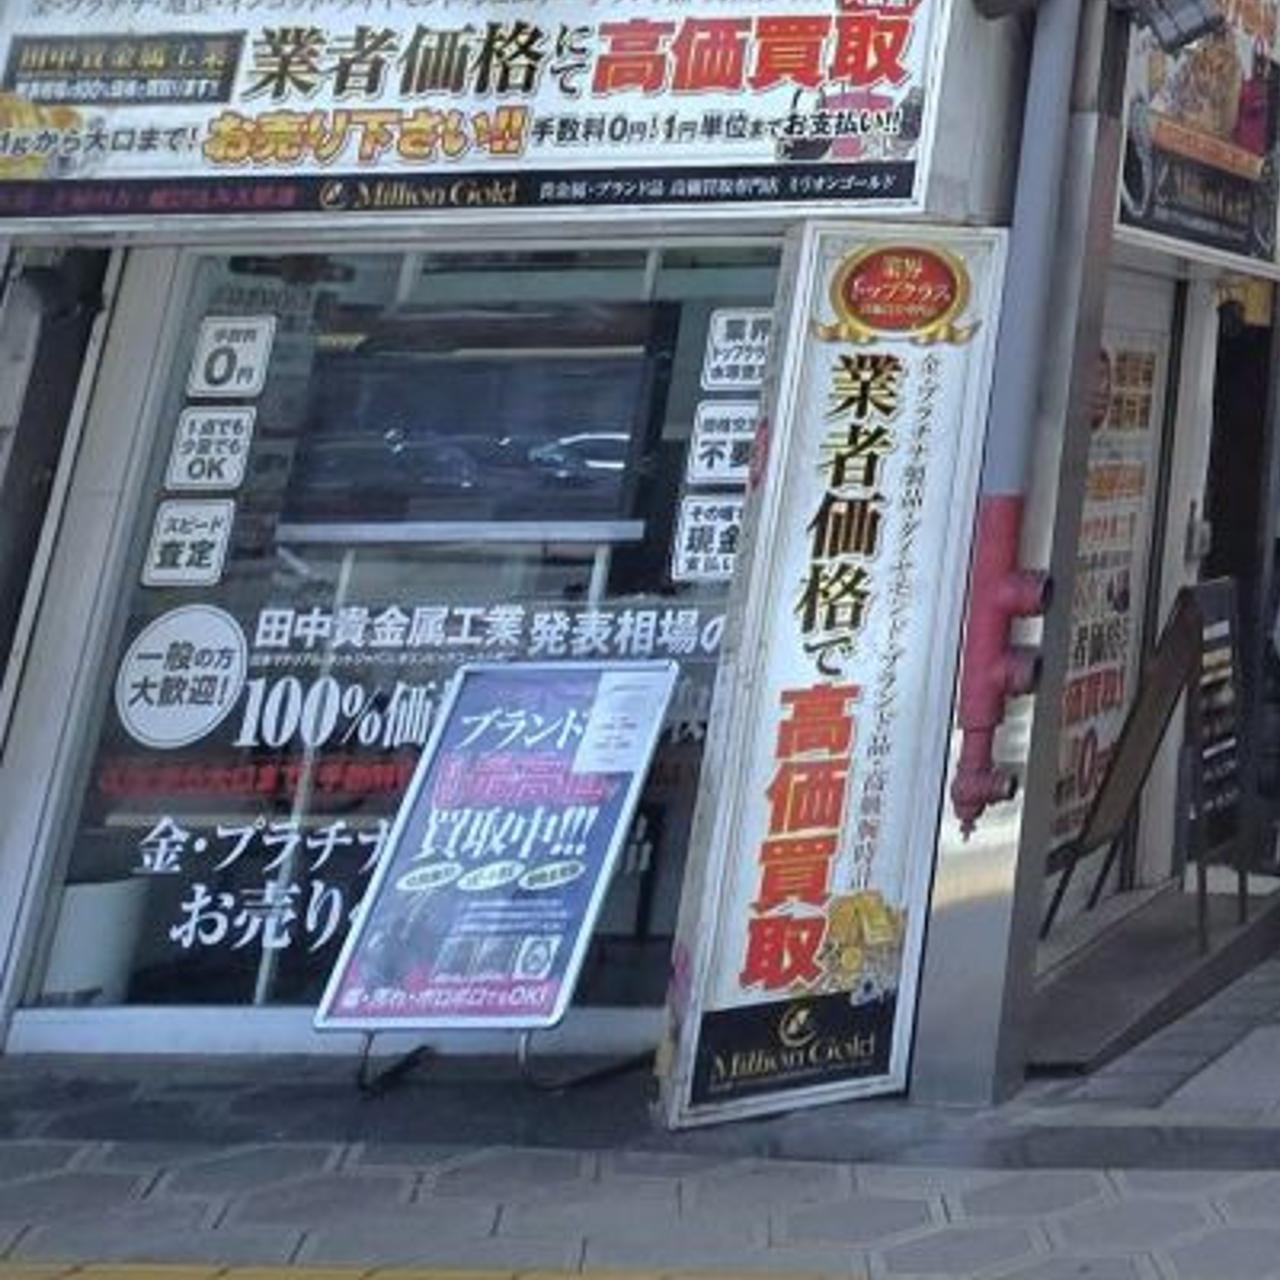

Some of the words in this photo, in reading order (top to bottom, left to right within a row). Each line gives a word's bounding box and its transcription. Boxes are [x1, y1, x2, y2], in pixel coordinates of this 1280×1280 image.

[354, 181, 445, 206] Million
[450, 179, 517, 204] Gold
[789, 174, 896, 194] ミリオンゴールド
[188, 457, 228, 481] OK
[154, 541, 216, 570] 査定
[254, 606, 522, 650] 田中貴金属工業
[528, 607, 726, 656] 発表相場の
[137, 641, 236, 671] 一般の方
[129, 675, 228, 708] 大歓迎!
[233, 675, 450, 748] 100%価
[456, 708, 587, 750] ブランド
[170, 880, 363, 950] お売り
